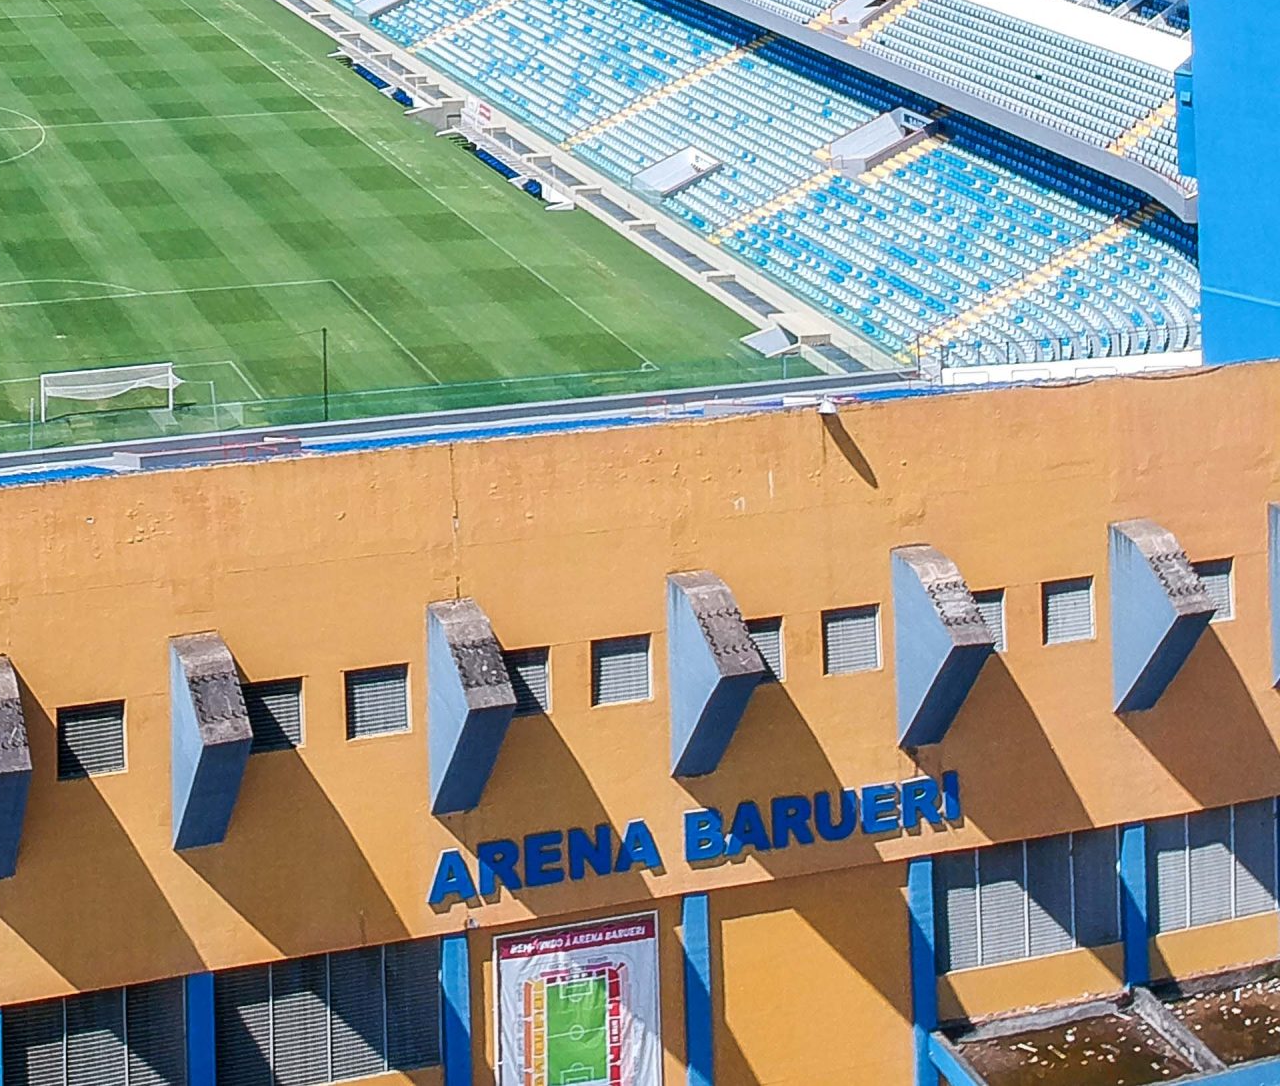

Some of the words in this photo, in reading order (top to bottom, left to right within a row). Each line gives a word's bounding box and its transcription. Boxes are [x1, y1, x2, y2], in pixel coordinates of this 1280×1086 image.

[427, 818, 664, 904] ARENA
[683, 770, 961, 862] BARUERI
[572, 932, 603, 945] ARENA
[604, 926, 646, 941] BARUERI
